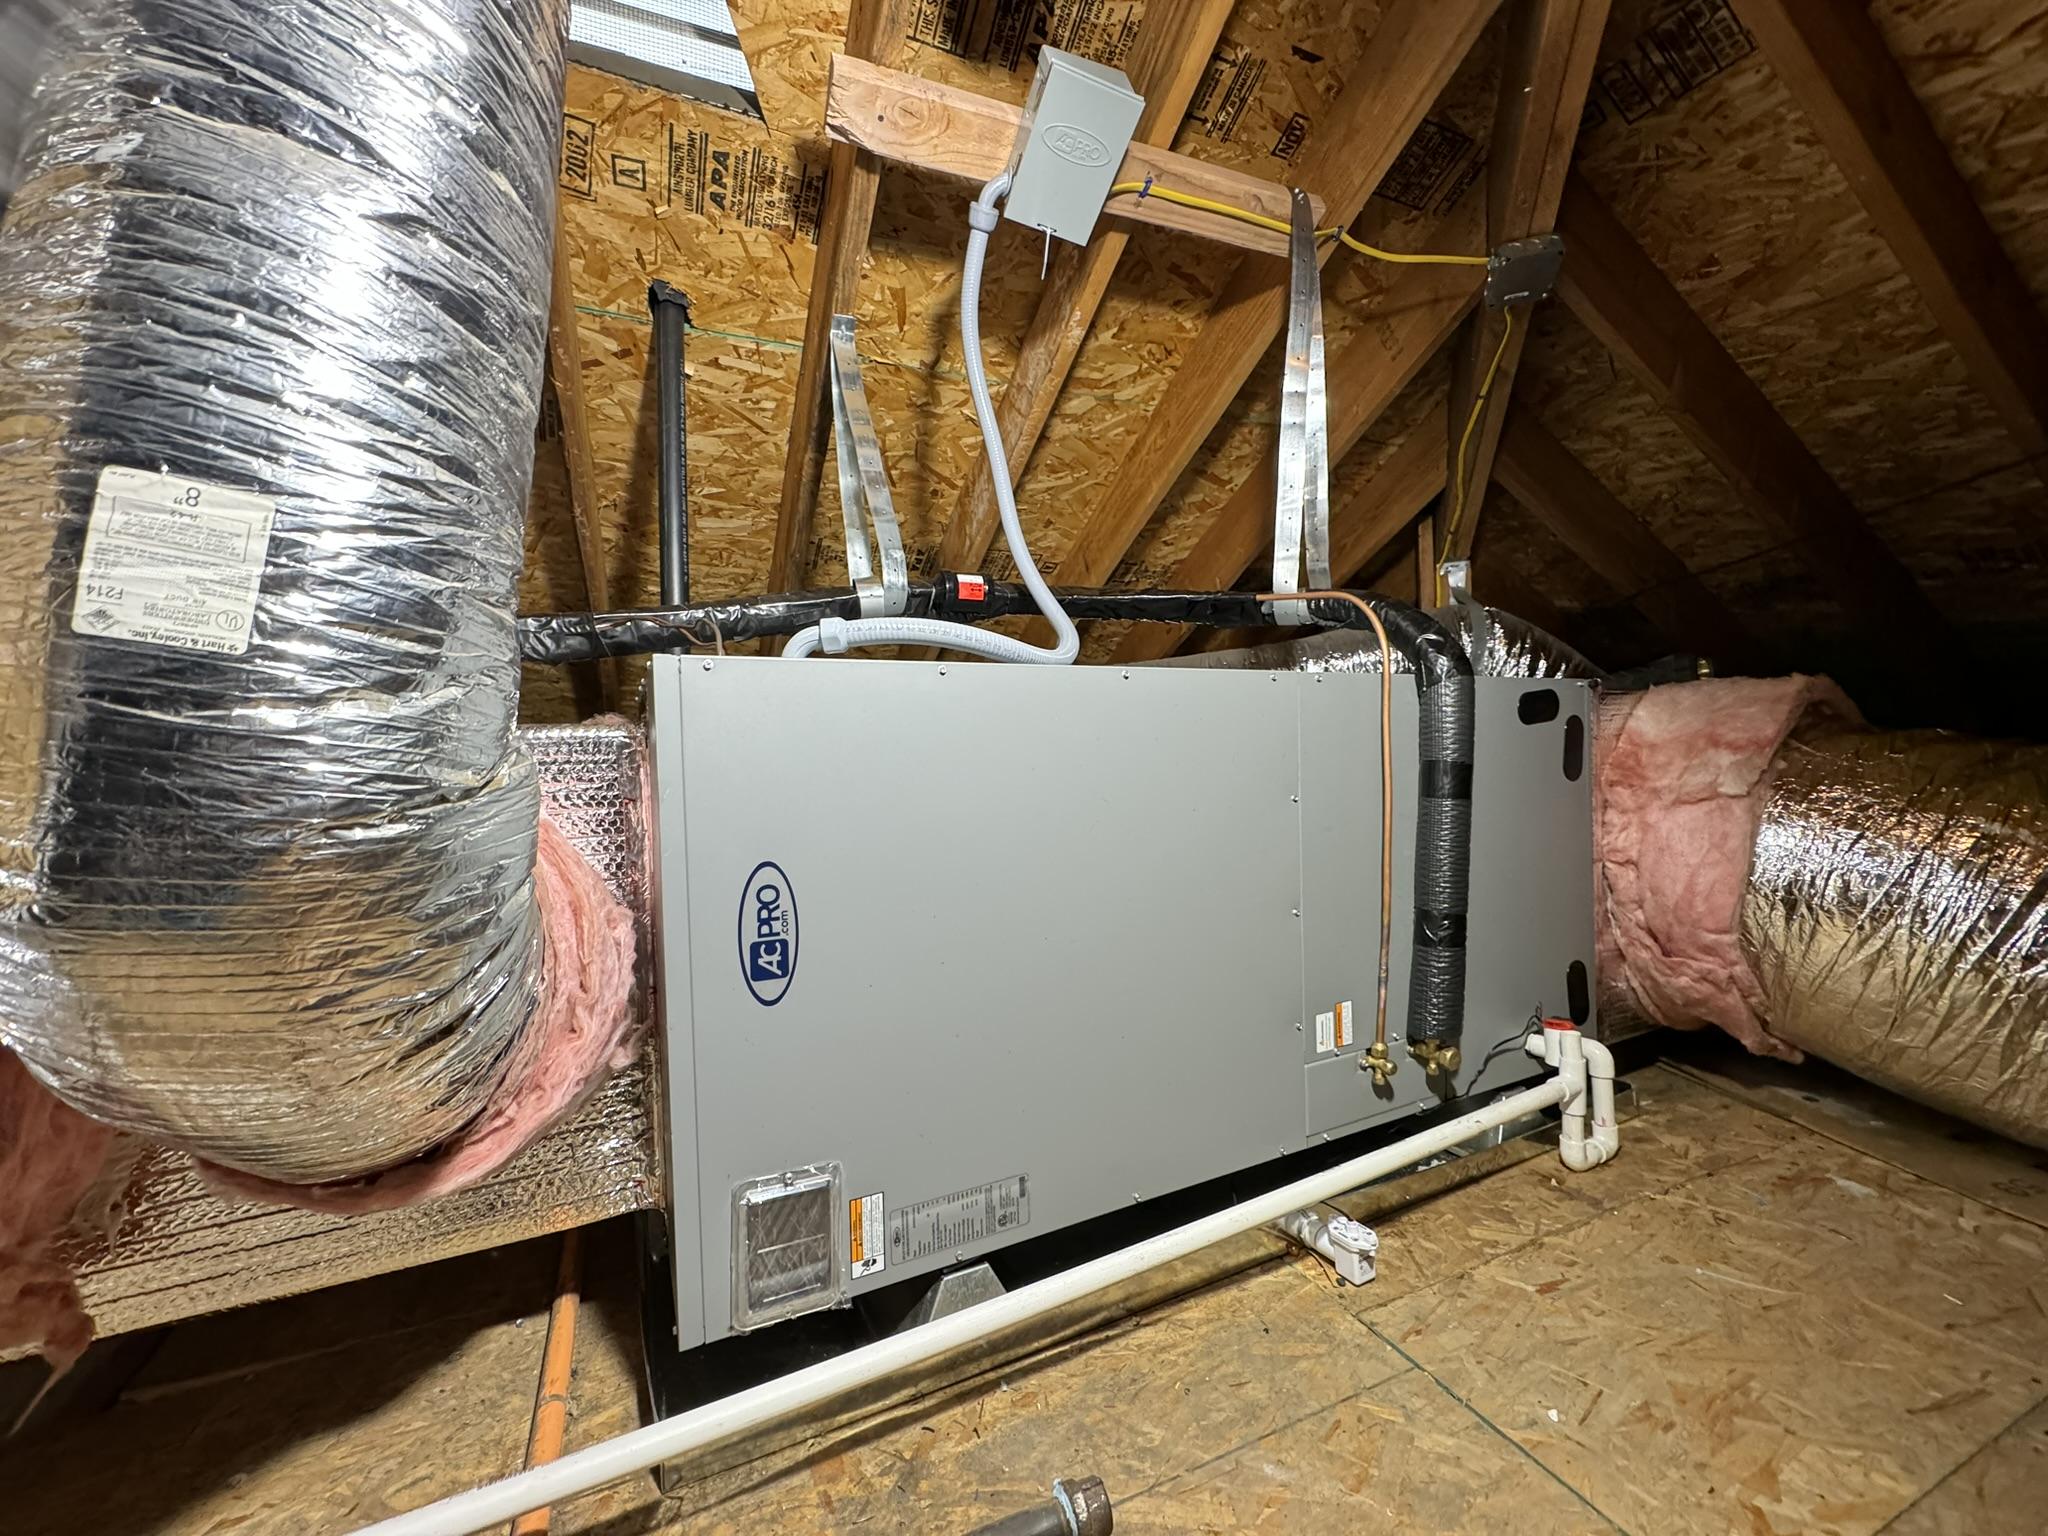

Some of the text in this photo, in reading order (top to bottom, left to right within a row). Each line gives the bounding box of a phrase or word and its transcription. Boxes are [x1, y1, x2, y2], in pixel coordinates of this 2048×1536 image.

[919, 9, 935, 37] THIS
[936, 12, 955, 46] MADE
[1279, 118, 1305, 156] NOV
[567, 129, 589, 182] 2002
[672, 142, 685, 195] AINSWORTH
[684, 129, 698, 212] LUMBER COMPANY
[621, 166, 640, 181] A
[709, 150, 730, 211] APA
[730, 154, 741, 198] ENGINEERED
[734, 149, 749, 220] WOOD ASSOCIATION
[761, 198, 775, 230] 32/16
[792, 193, 801, 210] 454
[85, 582, 123, 599] F214
[163, 592, 189, 602] DUCT
[189, 637, 199, 646] &
[201, 639, 225, 650] Hart
[780, 910, 788, 935] .com
